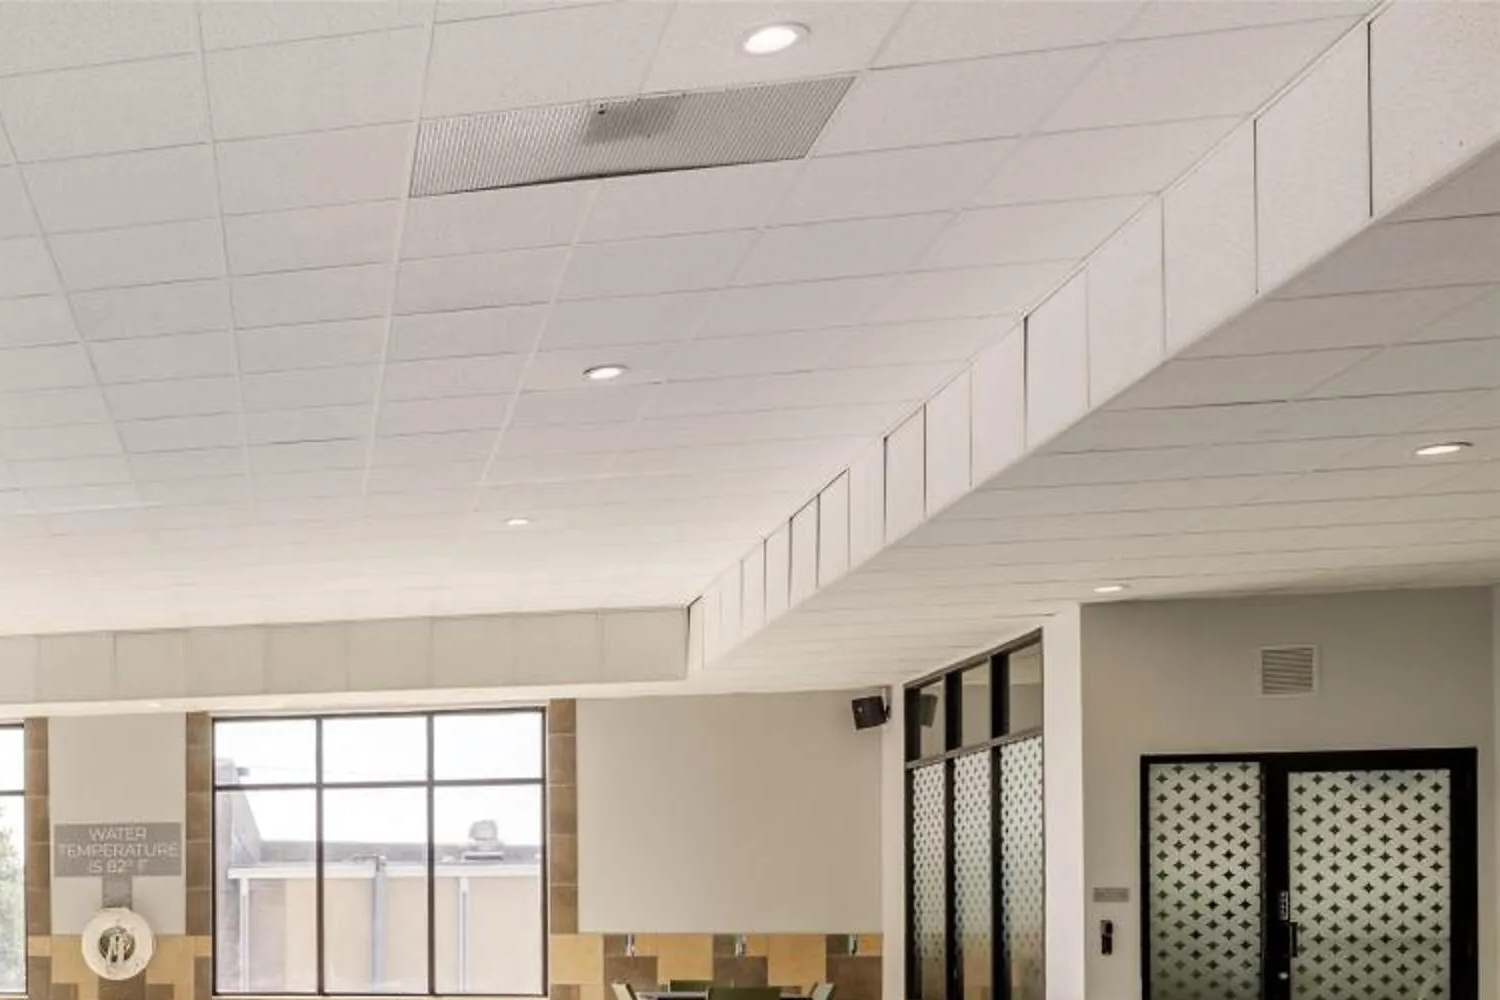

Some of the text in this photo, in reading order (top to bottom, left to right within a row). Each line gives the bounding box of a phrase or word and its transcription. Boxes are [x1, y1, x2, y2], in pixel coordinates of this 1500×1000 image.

[88, 826, 147, 842] WATER
[58, 841, 181, 858] TEMPERATURE
[89, 859, 103, 874] IS
